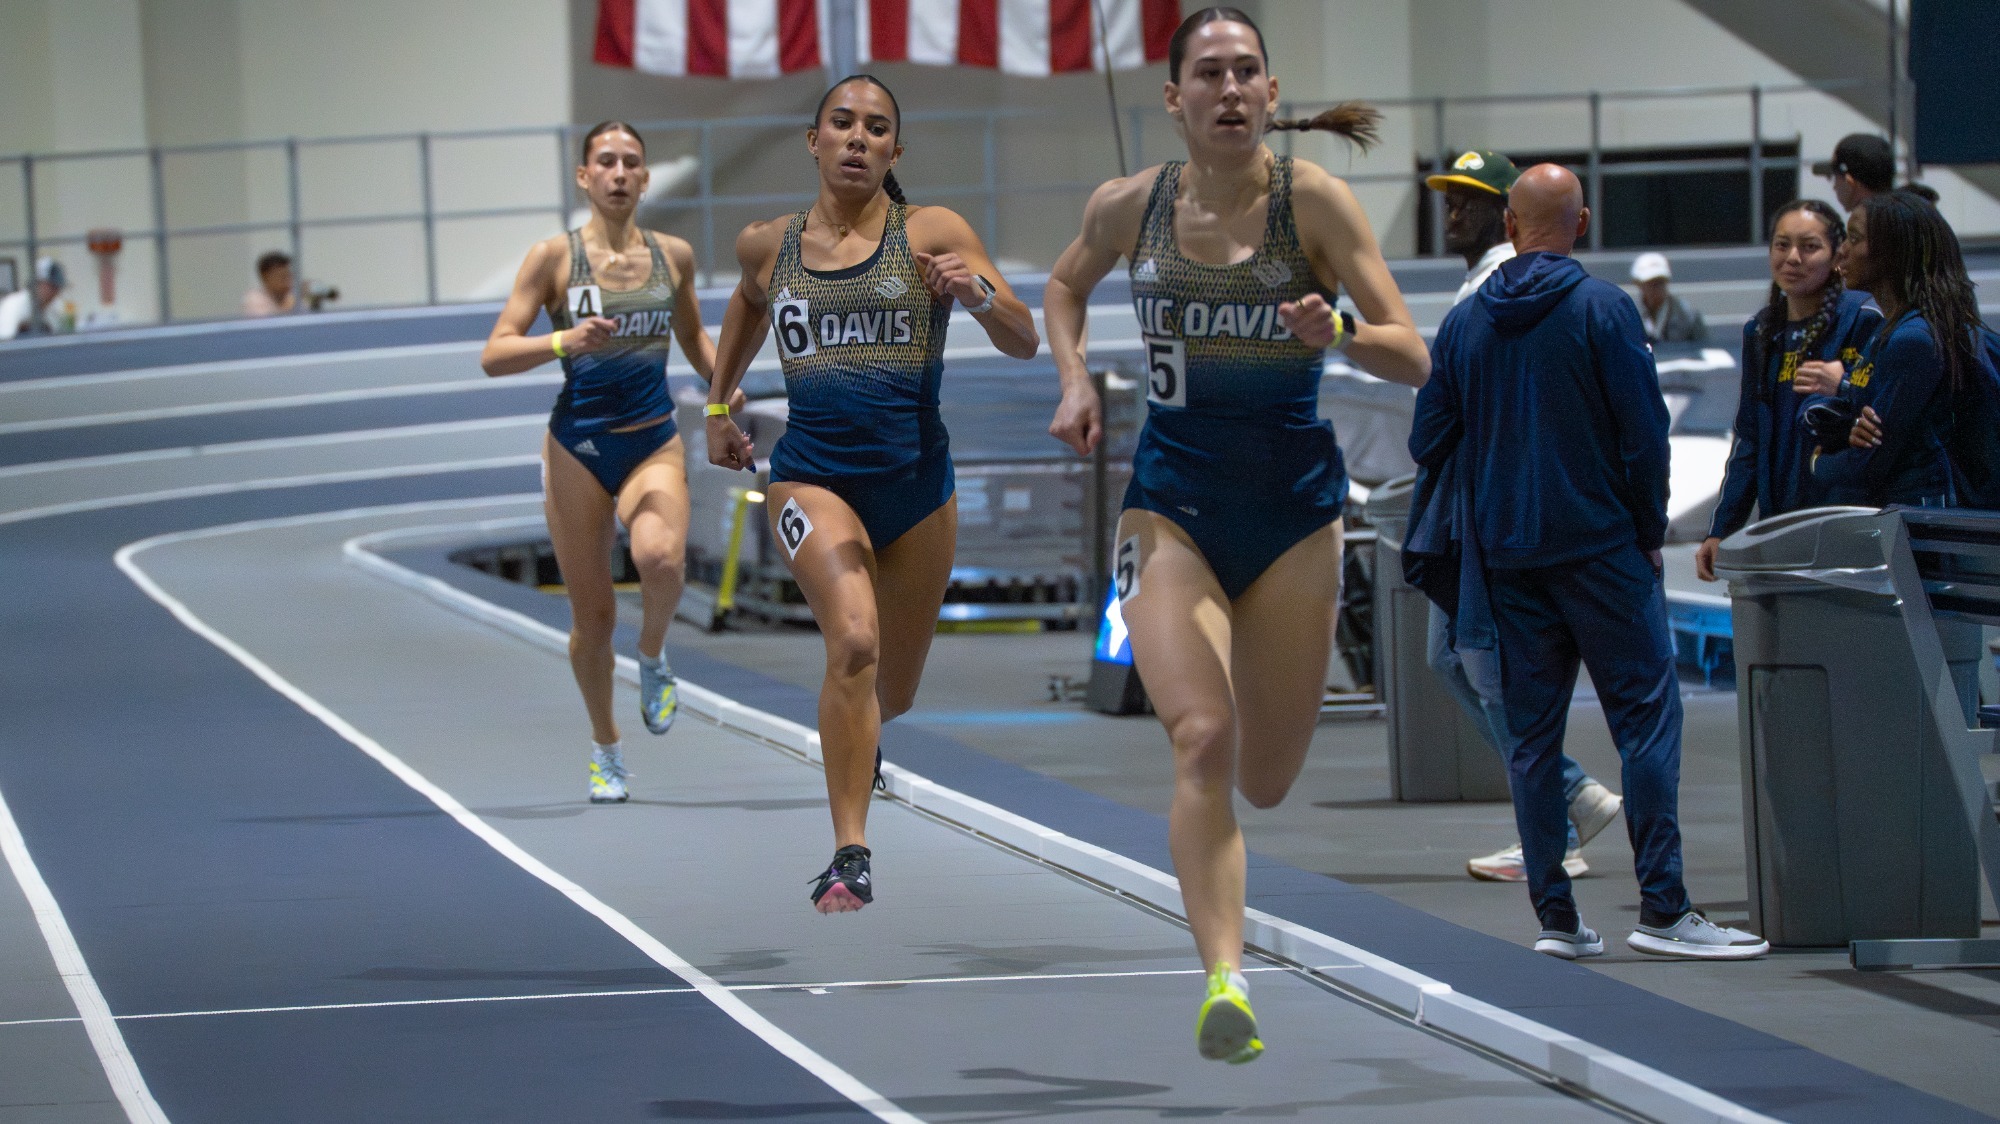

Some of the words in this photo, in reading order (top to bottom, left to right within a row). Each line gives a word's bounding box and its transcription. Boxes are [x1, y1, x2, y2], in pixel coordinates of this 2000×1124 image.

[577, 289, 597, 318] 4
[609, 310, 672, 337] DAVIS
[1137, 297, 1173, 335] UC
[779, 305, 808, 353] 6
[820, 311, 911, 347] DAVIS
[1150, 340, 1176, 400] 5
[781, 507, 805, 549] 6
[1118, 541, 1134, 601] 5
